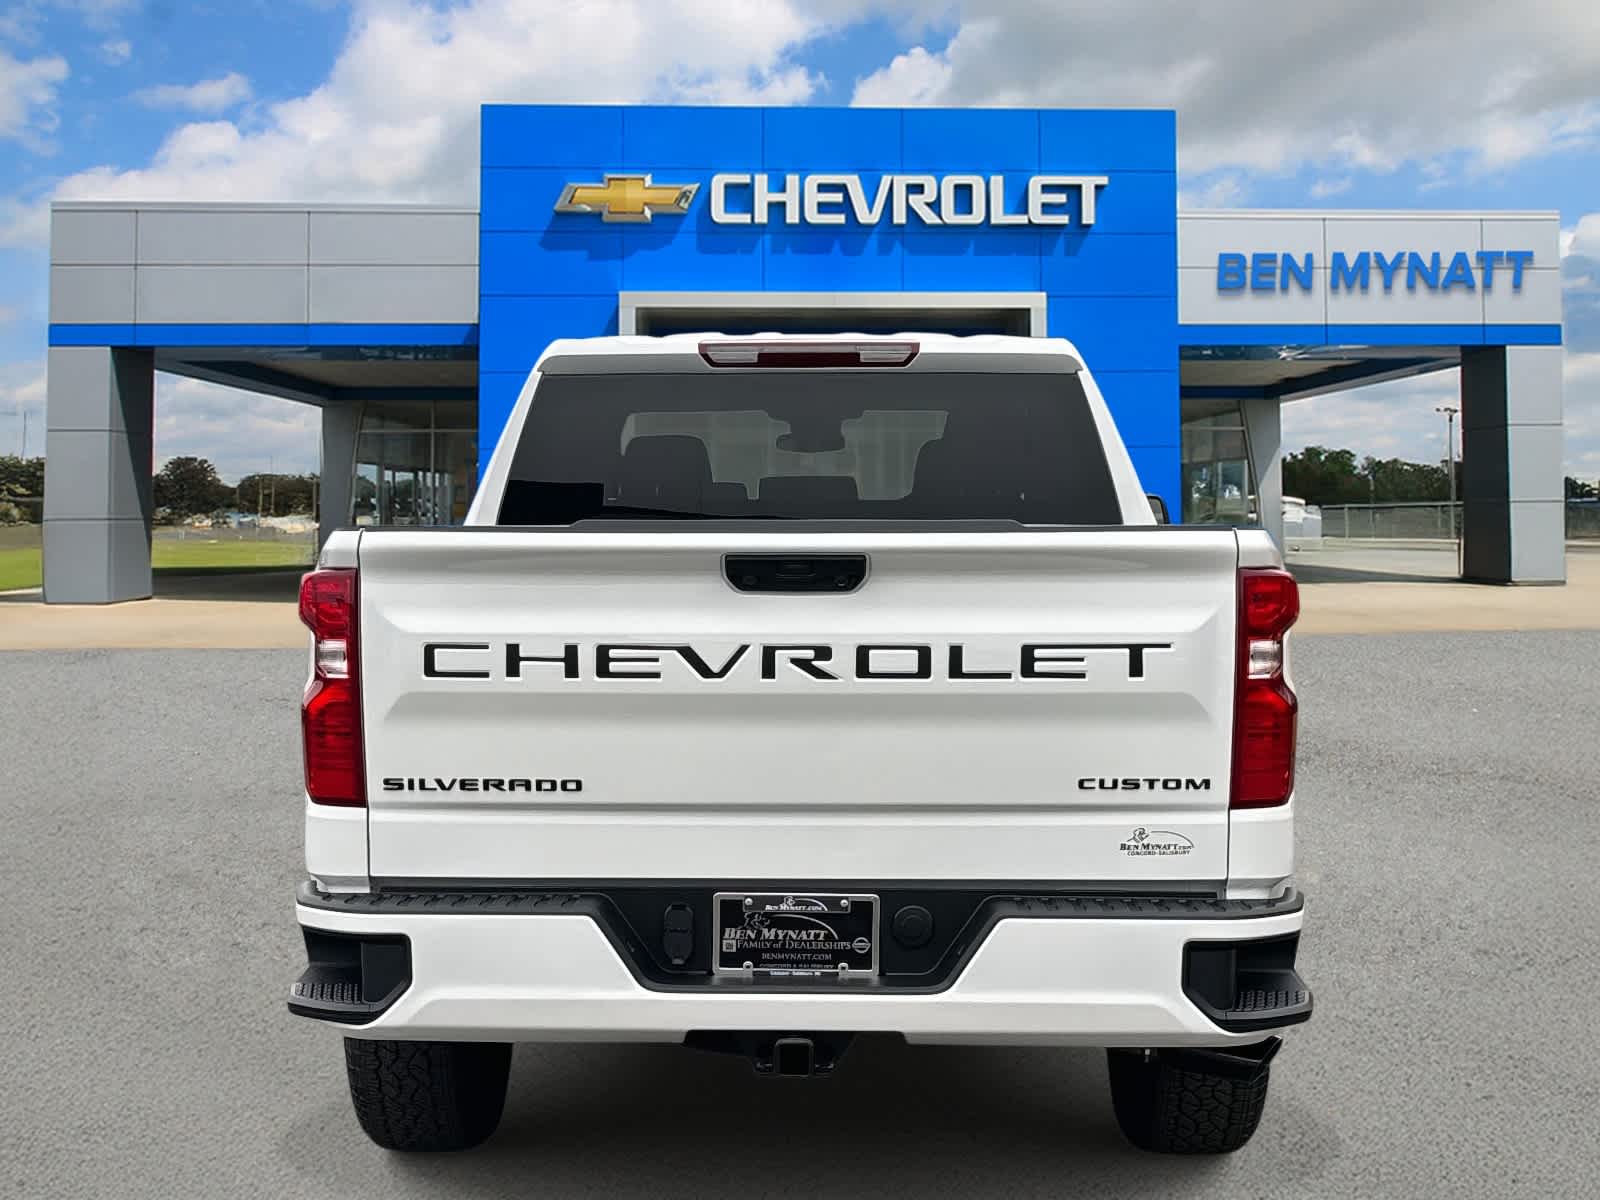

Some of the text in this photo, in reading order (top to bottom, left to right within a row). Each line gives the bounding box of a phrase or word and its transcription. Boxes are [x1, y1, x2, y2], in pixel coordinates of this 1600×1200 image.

[710, 173, 1109, 226] CHEVROLET
[1217, 250, 1534, 290] BEN MYNATT
[423, 643, 1172, 680] CHEVROLET
[382, 777, 583, 792] SILVERADO
[1077, 778, 1211, 791] CUSTOM
[1120, 843, 1139, 851] BEN
[723, 927, 828, 941] BEN MYNATT
[737, 940, 772, 949] FAMILY
[785, 940, 851, 950] DEALERSHIPS
